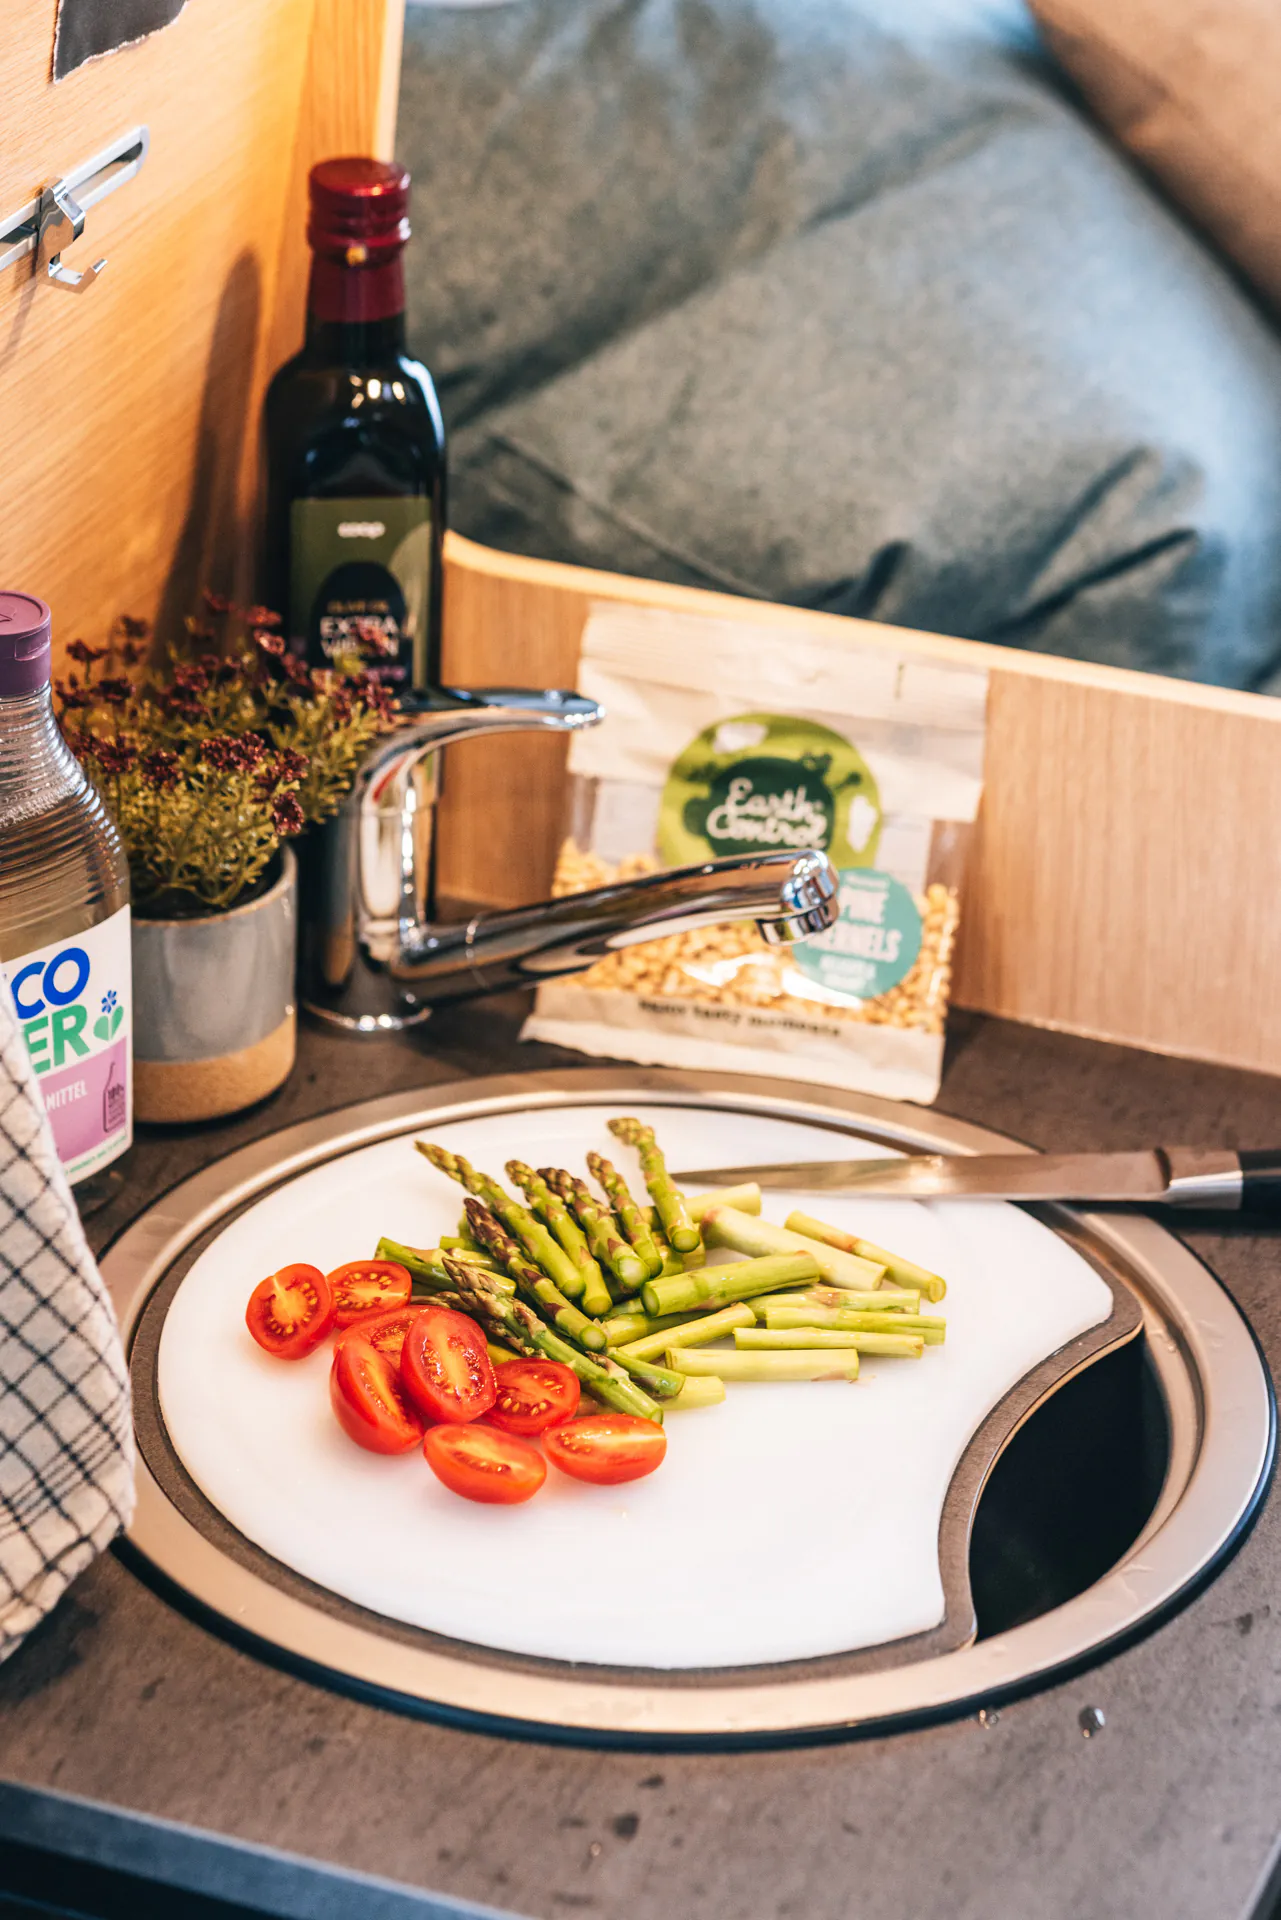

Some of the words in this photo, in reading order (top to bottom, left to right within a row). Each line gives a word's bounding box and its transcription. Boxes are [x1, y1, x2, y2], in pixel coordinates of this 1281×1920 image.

[727, 777, 812, 820] Earth
[706, 804, 828, 849] Control
[10, 947, 90, 1019] CO
[24, 1004, 90, 1073] ER
[46, 1079, 88, 1111] MITTEL
